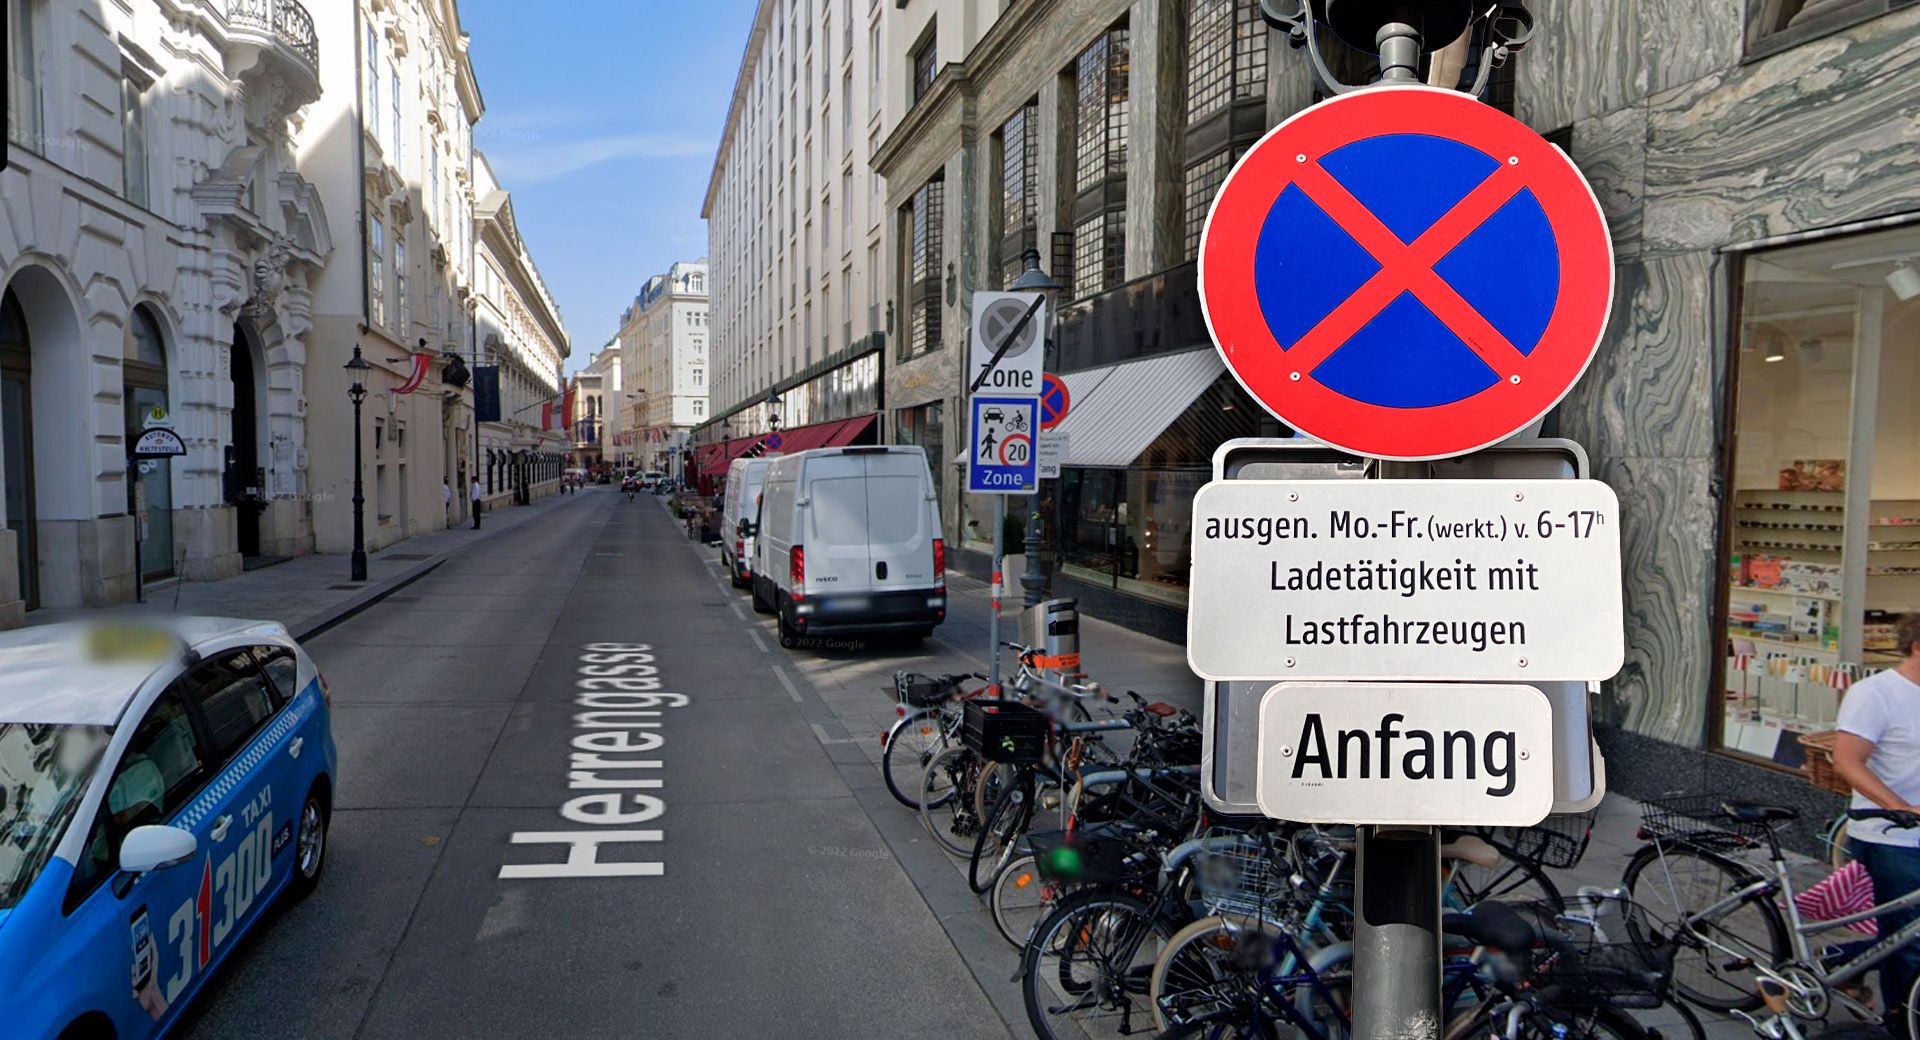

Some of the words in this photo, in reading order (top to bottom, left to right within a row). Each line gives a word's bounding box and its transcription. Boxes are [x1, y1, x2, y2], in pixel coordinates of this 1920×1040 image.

[980, 364, 1033, 388] Zone
[1008, 443, 1027, 462] 20
[983, 470, 1023, 485] Zone
[1205, 517, 1318, 546] ausgen.
[1428, 515, 1507, 542] (werkt.)
[1514, 523, 1529, 539] v.
[1271, 558, 1477, 598] Ladetätigkeit
[1488, 558, 1540, 591] mit
[1285, 613, 1526, 652] Lastfahrzeugen
[499, 642, 690, 879] Herrengasse
[1291, 713, 1516, 797] Anfang
[241, 783, 272, 829] TAXI
[273, 827, 290, 853] PLUS
[166, 810, 273, 1005] 31300
